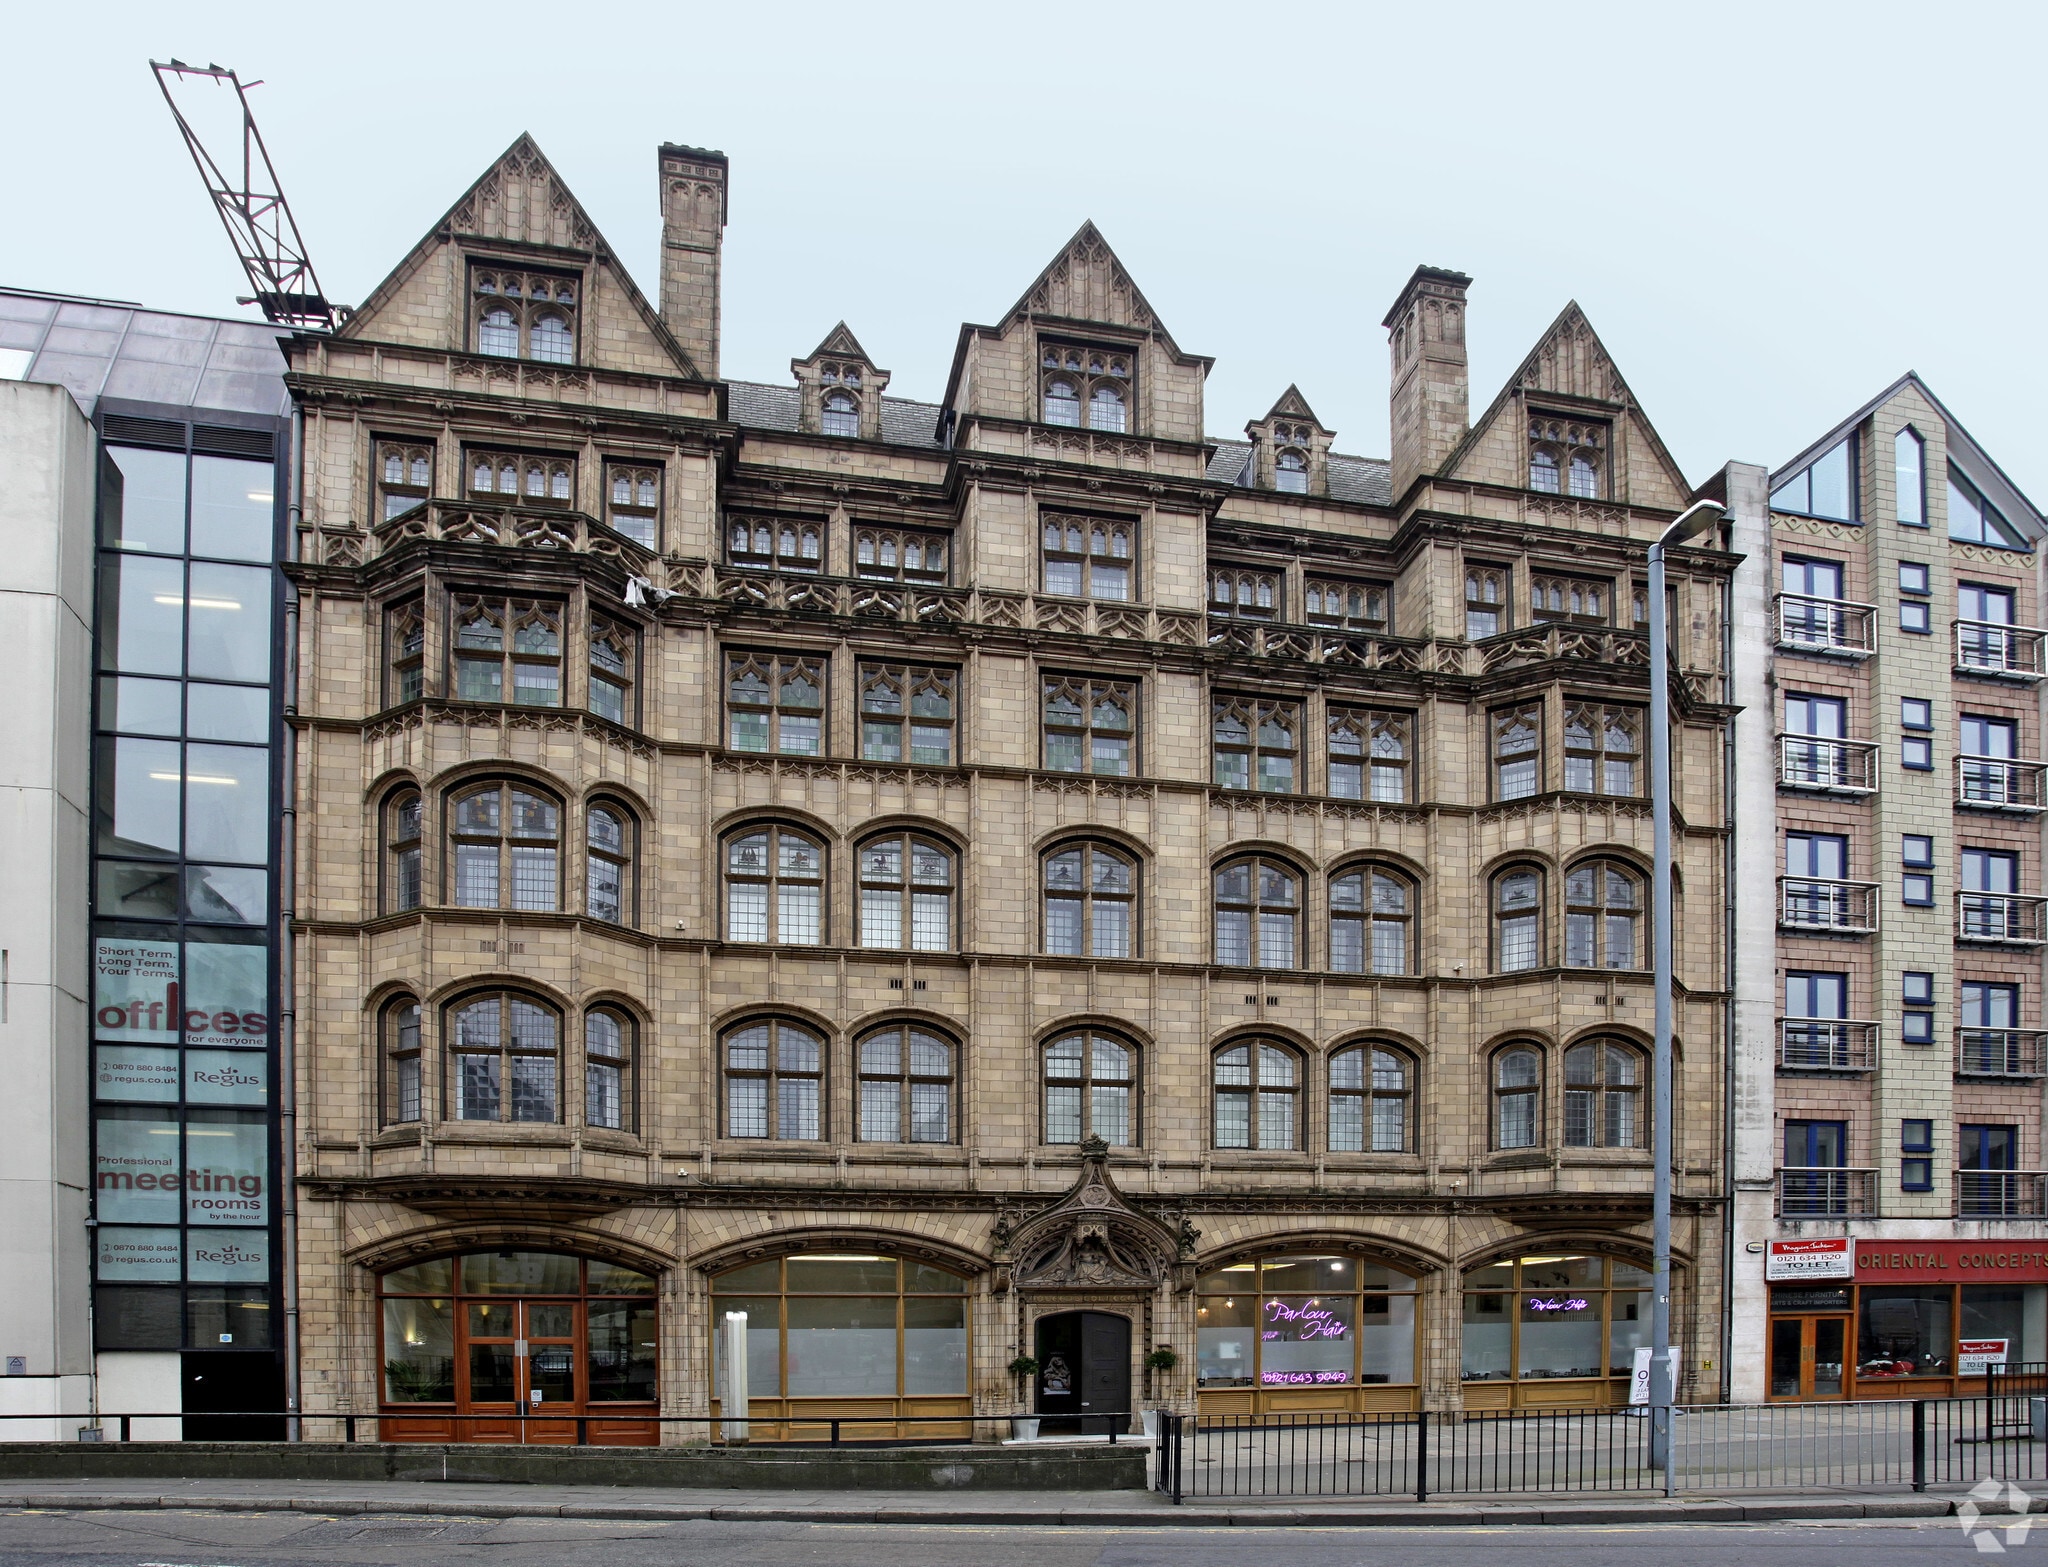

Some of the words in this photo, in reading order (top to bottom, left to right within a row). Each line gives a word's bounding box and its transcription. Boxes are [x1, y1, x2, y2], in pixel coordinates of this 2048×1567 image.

[99, 946, 134, 957] Short
[139, 949, 176, 959] Term.
[99, 957, 131, 967] Long
[136, 959, 173, 968] Term.
[99, 967, 130, 975] Your
[134, 969, 178, 978] Terms.
[98, 982, 267, 1035] offices
[208, 1036, 266, 1045] everyone.
[115, 1076, 176, 1084] regus.co.uk
[194, 1071, 259, 1087] Regus
[98, 1156, 172, 1166] Professional
[98, 1169, 261, 1198] meeting
[192, 1198, 260, 1209] rooms
[116, 1256, 178, 1264] regus.co.uk
[196, 1250, 261, 1265] Regus
[1858, 1253, 1948, 1269] ORIENTAL
[496, 1263, 542, 1283] 38
[1265, 1300, 1333, 1322] Parlour
[1301, 1319, 1347, 1339] Hair
[1264, 1372, 1288, 1382] 0121
[1290, 1373, 1312, 1383] 643
[1316, 1372, 1346, 1382] 9049
